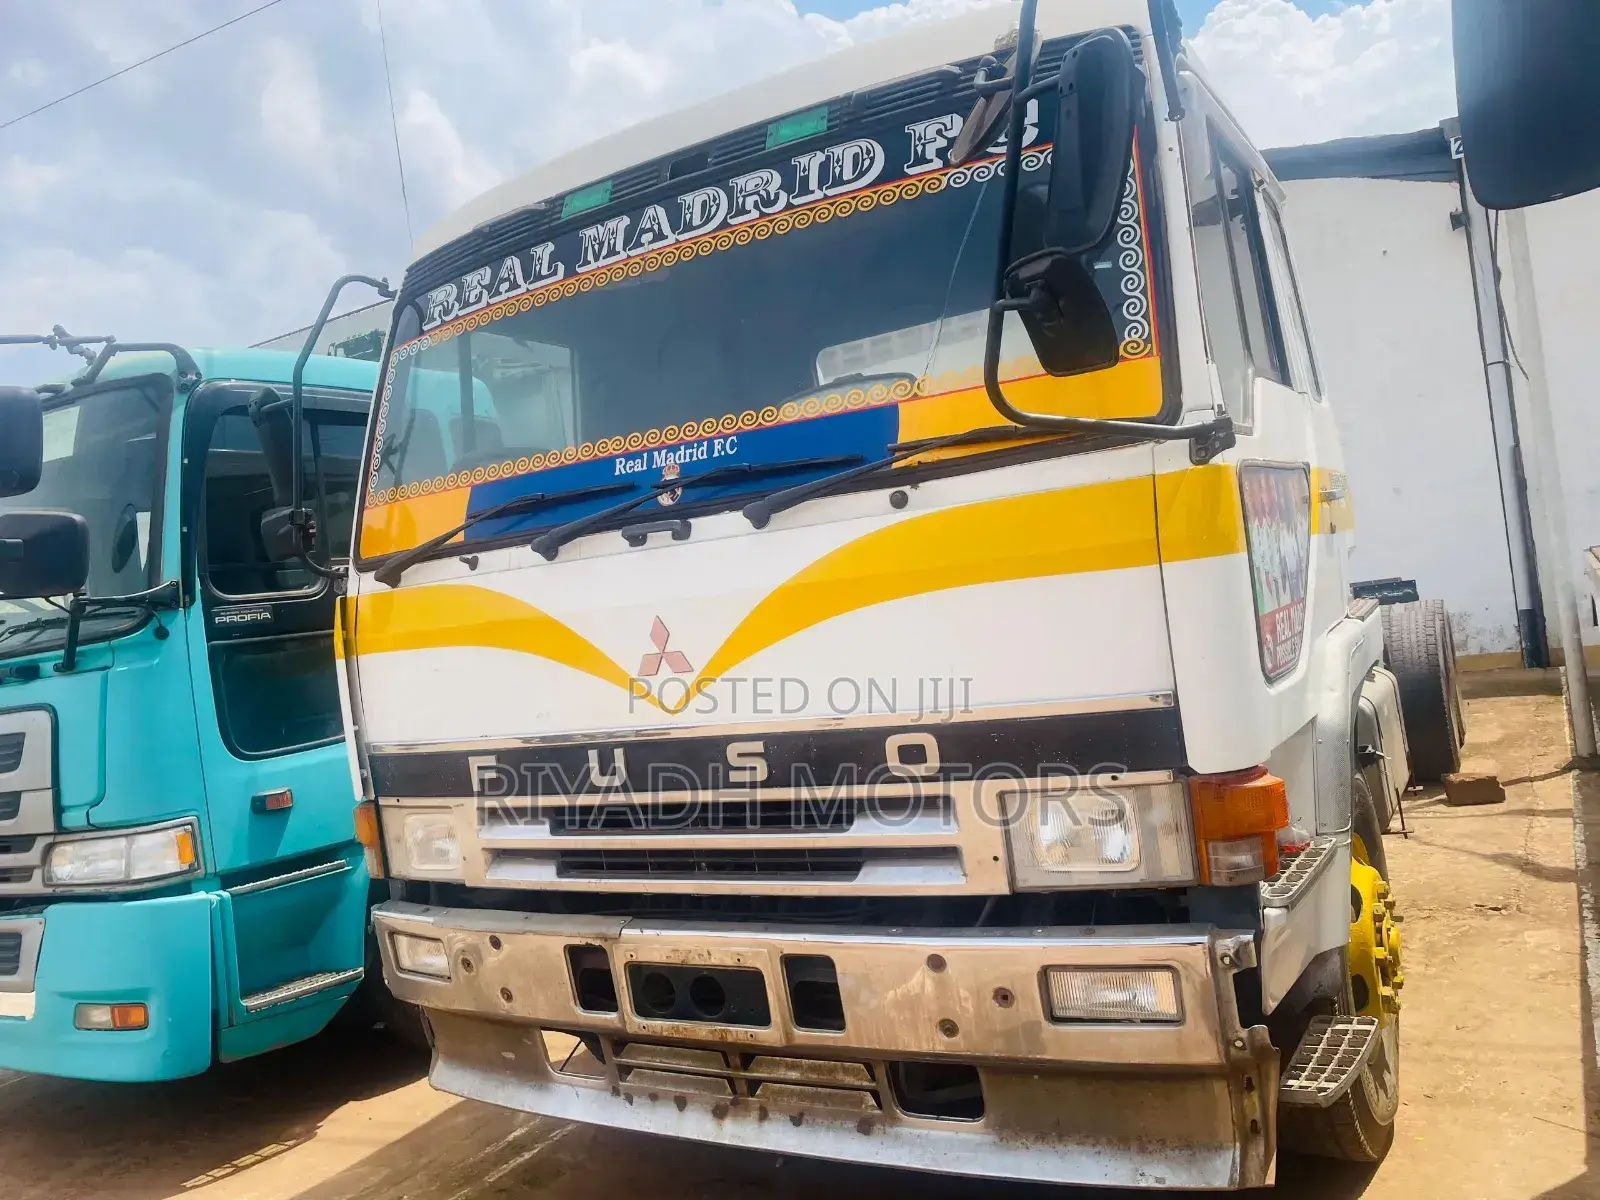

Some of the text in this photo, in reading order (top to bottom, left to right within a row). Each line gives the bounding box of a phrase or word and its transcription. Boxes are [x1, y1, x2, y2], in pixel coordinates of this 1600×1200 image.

[422, 98, 1040, 331] REAL MADRID FC
[614, 435, 738, 475] Real Madrid F.C
[214, 612, 272, 624] PROFIA
[468, 732, 941, 793] FUSO
